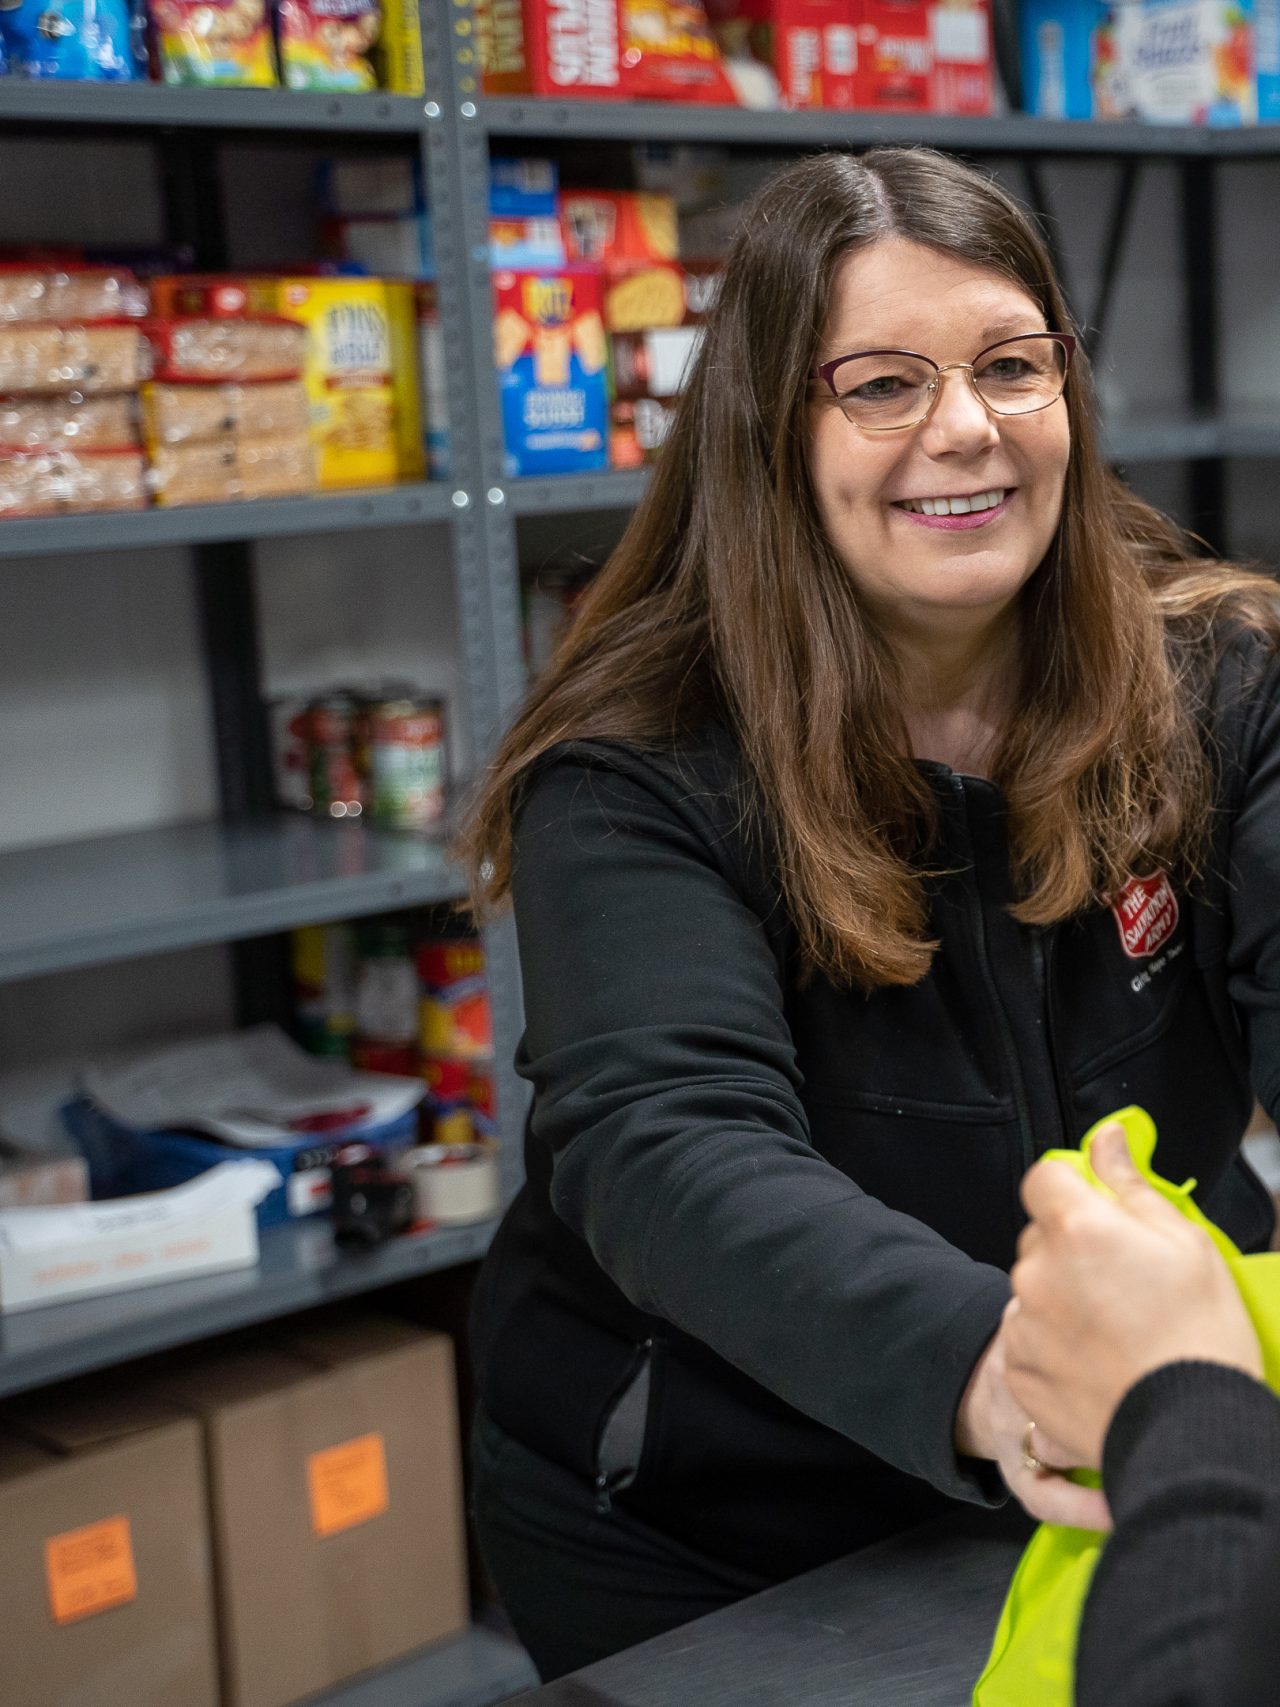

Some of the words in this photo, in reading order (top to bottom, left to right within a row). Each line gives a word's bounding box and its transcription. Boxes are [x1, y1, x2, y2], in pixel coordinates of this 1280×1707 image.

[1122, 885, 1147, 919] THE
[1125, 880, 1170, 950] SALVATION
[1145, 903, 1171, 952] ARMY
